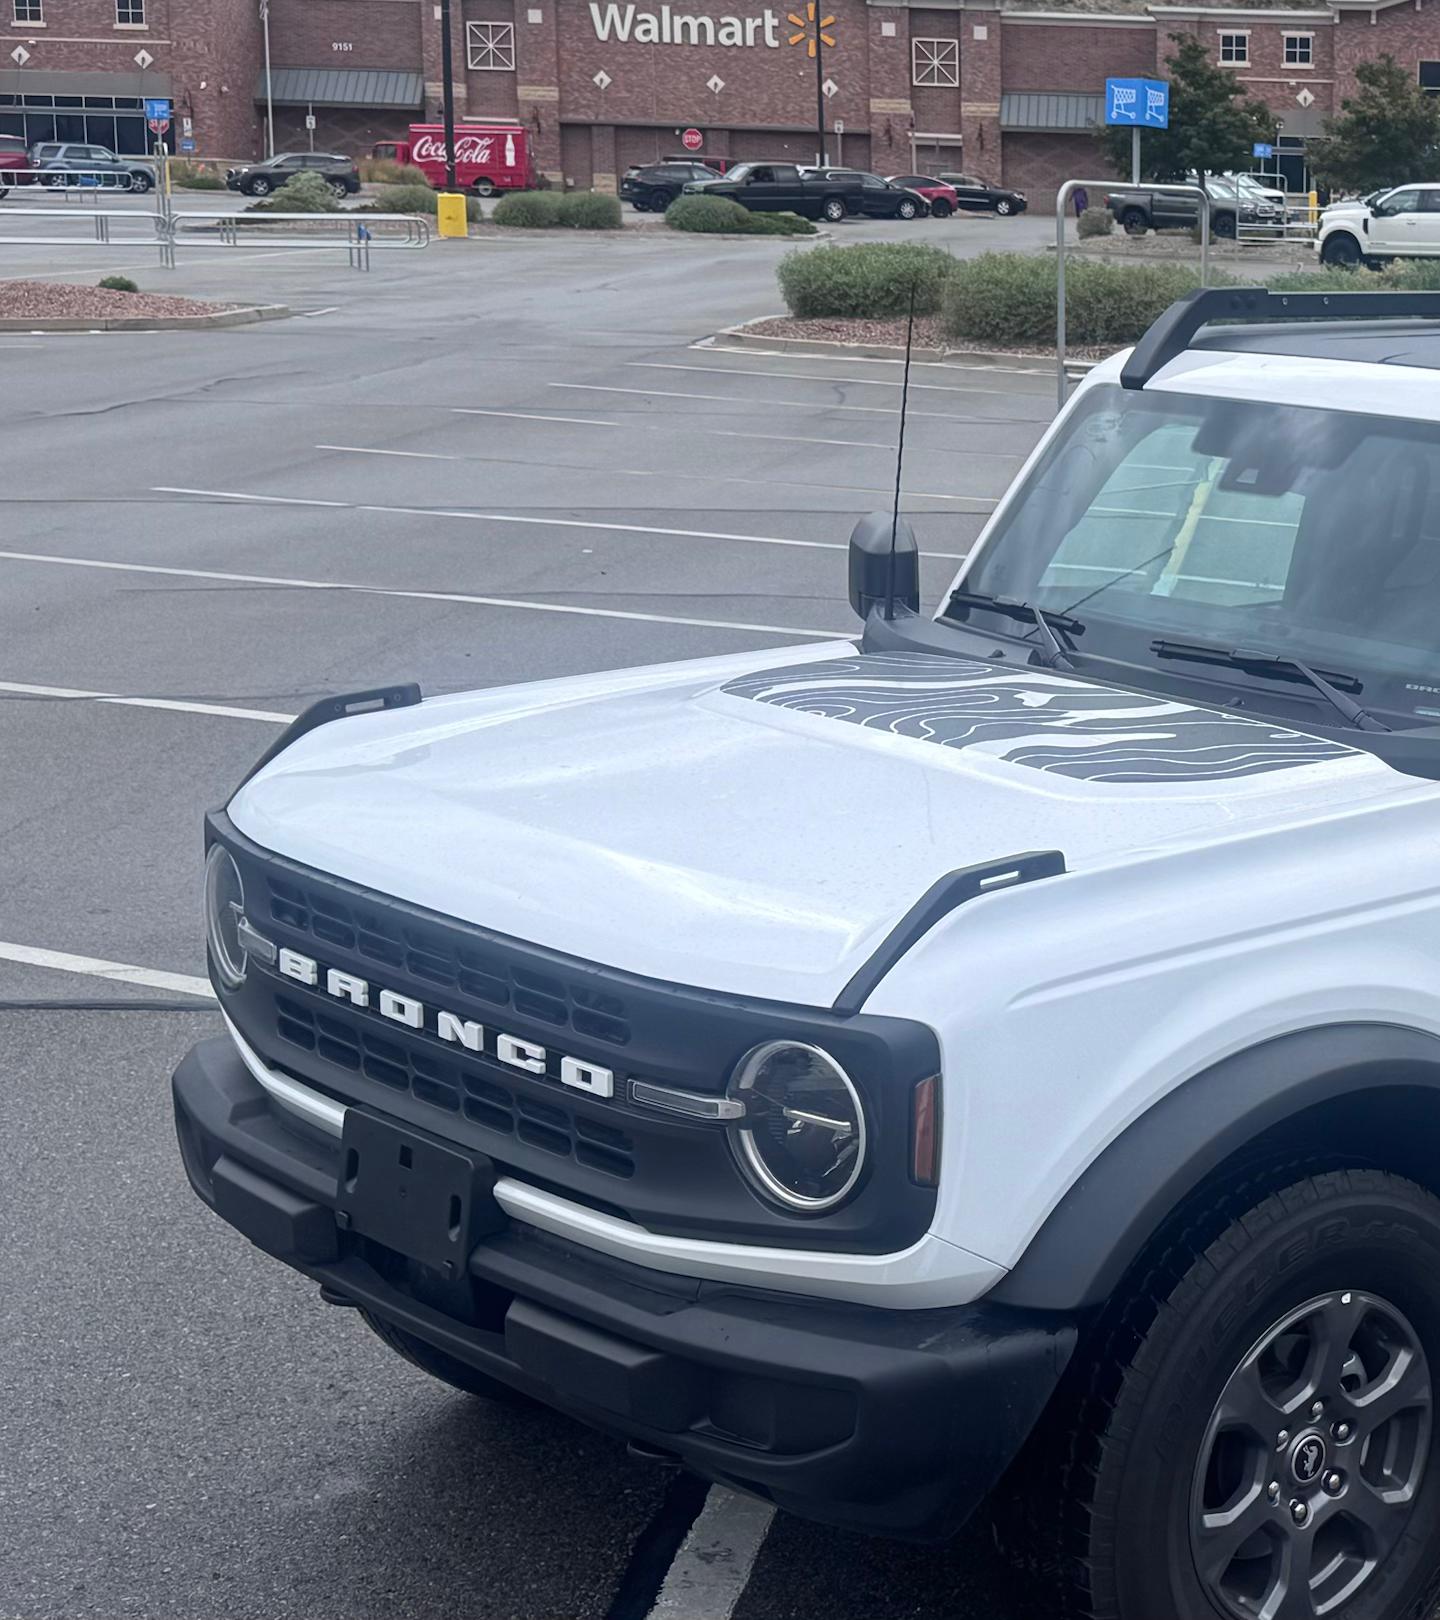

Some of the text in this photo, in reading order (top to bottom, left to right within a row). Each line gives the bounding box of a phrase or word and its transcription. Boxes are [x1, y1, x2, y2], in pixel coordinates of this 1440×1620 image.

[589, 2, 780, 48] Walmart
[331, 42, 353, 51] 9151
[684, 134, 701, 144] STOP
[279, 947, 614, 1098] BRONCO
